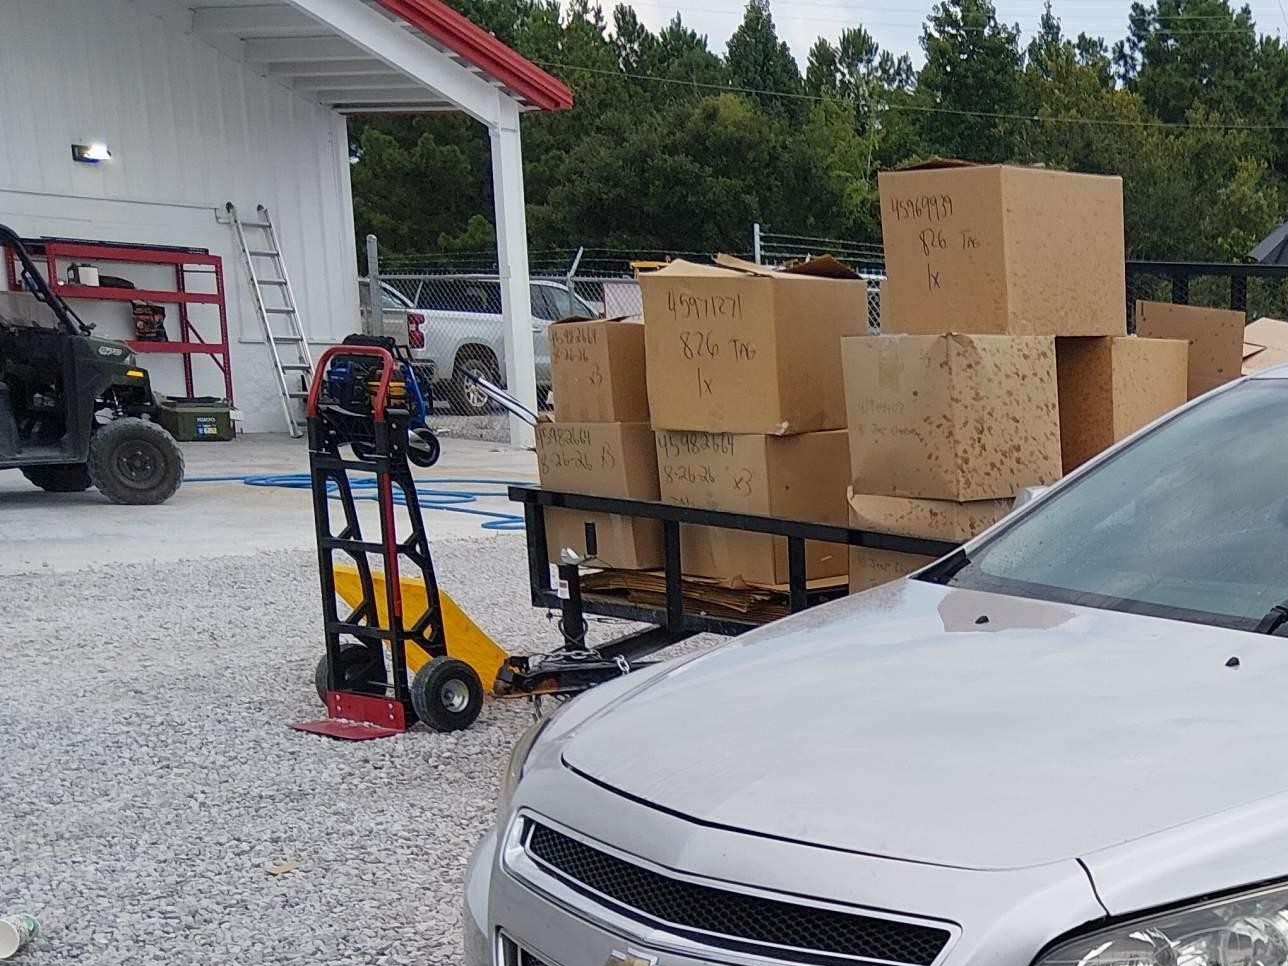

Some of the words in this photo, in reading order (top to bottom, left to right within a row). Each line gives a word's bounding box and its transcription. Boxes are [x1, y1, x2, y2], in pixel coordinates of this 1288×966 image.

[891, 195, 953, 221] 45969939
[920, 228, 947, 256] 826
[667, 288, 742, 320] 45971271
[680, 330, 719, 360] 826
[658, 432, 734, 457] 45982664
